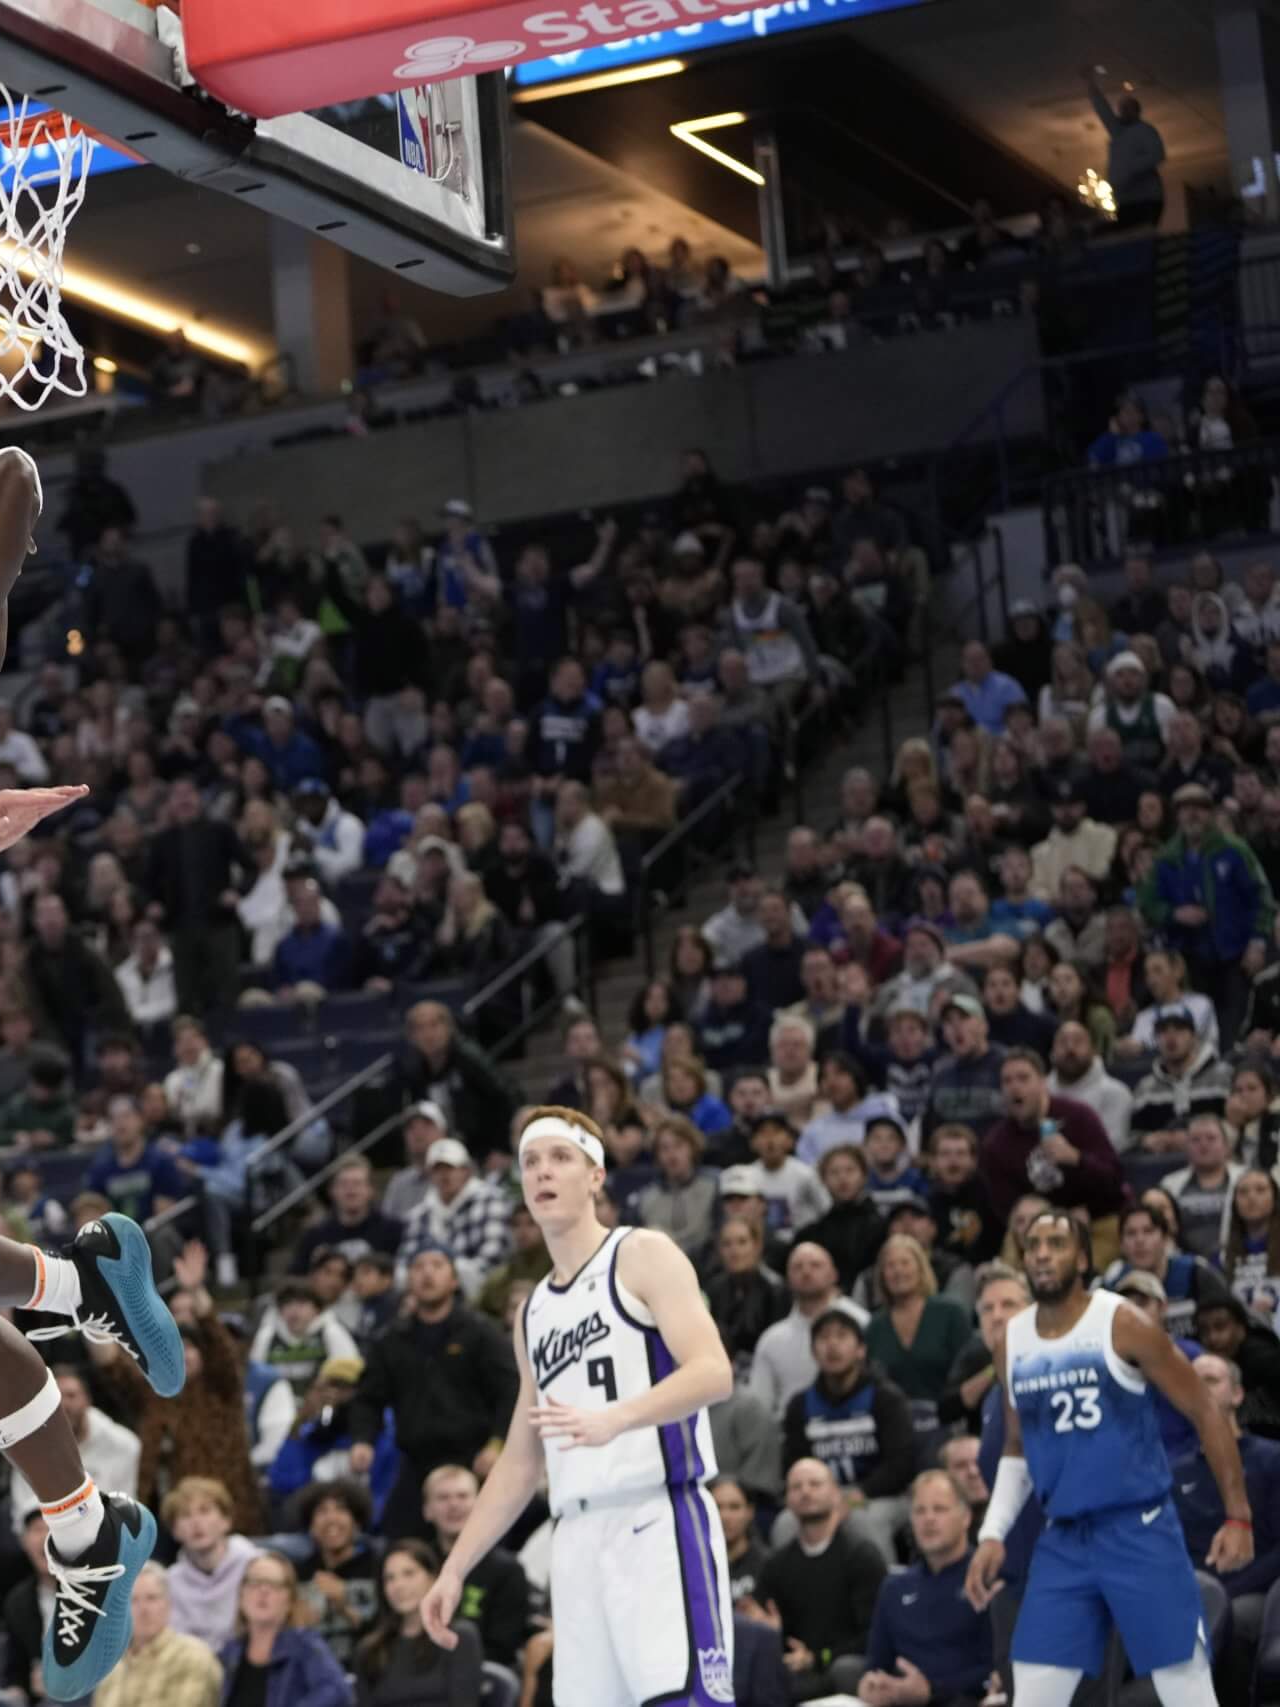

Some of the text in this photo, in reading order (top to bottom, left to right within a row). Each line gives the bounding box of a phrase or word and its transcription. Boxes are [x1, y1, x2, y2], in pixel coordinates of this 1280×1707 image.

[522, 0, 754, 47] Stat
[404, 138, 425, 171] NBA
[532, 1310, 610, 1390] Kings
[587, 1355, 618, 1403] 9
[1014, 1367, 1099, 1395] MINNESOTA
[1051, 1386, 1102, 1434] 23
